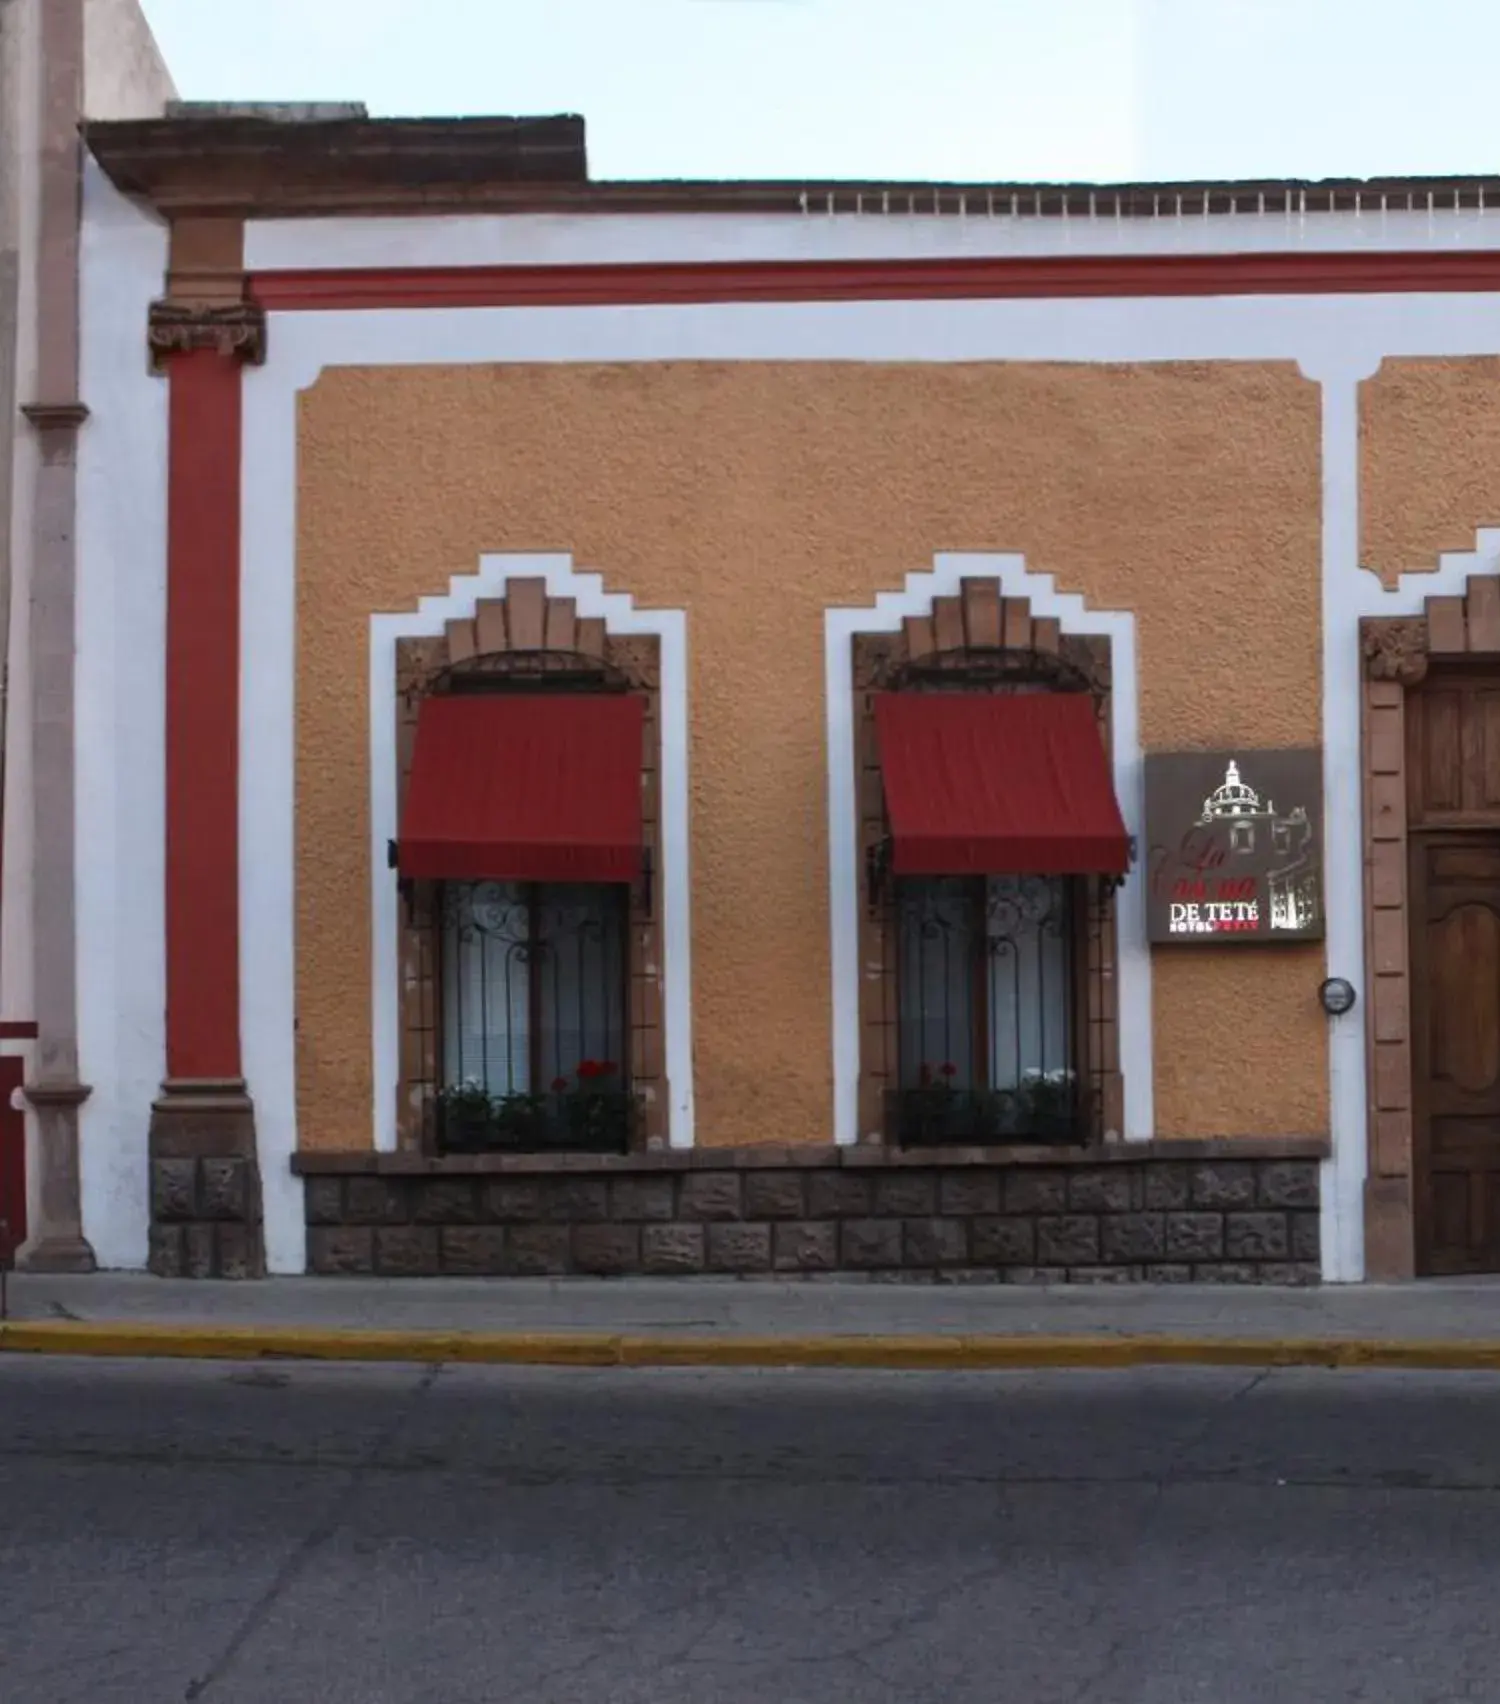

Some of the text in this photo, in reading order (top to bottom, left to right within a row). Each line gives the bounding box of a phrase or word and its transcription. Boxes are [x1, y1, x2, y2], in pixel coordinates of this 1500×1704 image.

[1169, 898, 1259, 921] DE TETÉ
[1169, 921, 1213, 933] HOTEL
